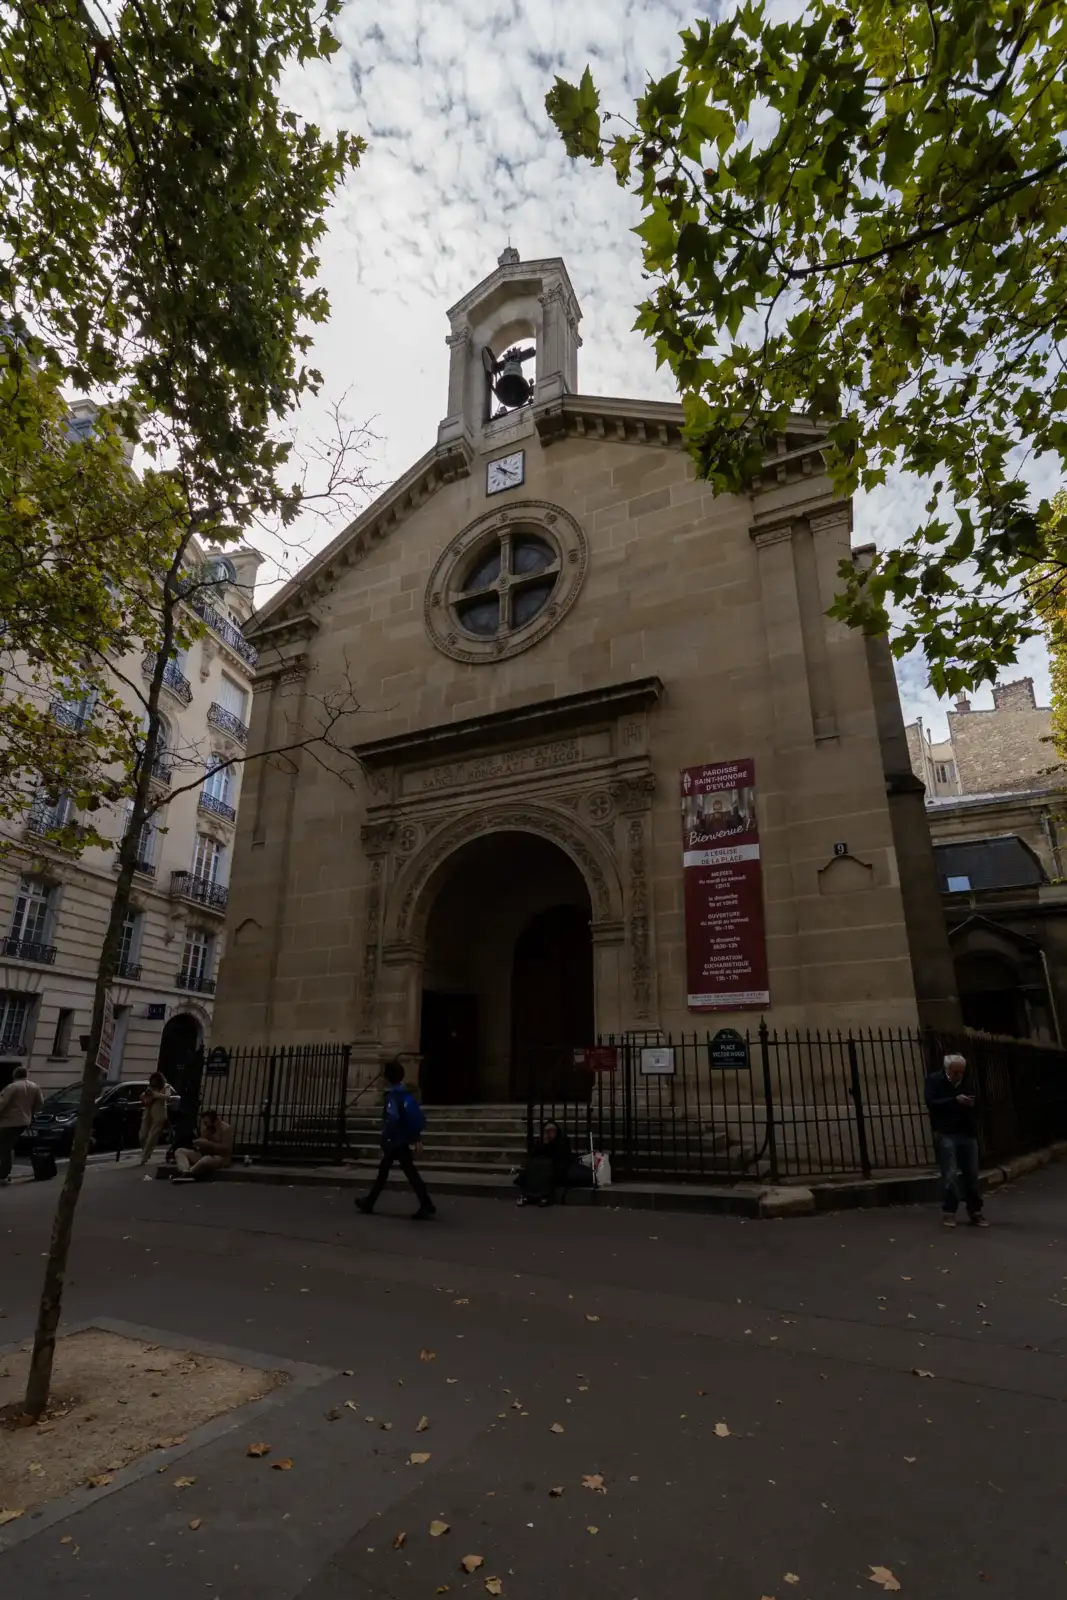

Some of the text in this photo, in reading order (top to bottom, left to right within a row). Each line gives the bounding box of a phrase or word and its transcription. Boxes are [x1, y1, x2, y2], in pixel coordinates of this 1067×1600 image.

[694, 769, 748, 786] SAINT-HONORÉ
[706, 780, 736, 791] D'EYLAU
[689, 825, 744, 846] Bienvenue
[837, 844, 845, 854] 9
[721, 854, 743, 863] PLACE
[710, 953, 743, 962] ADORATION
